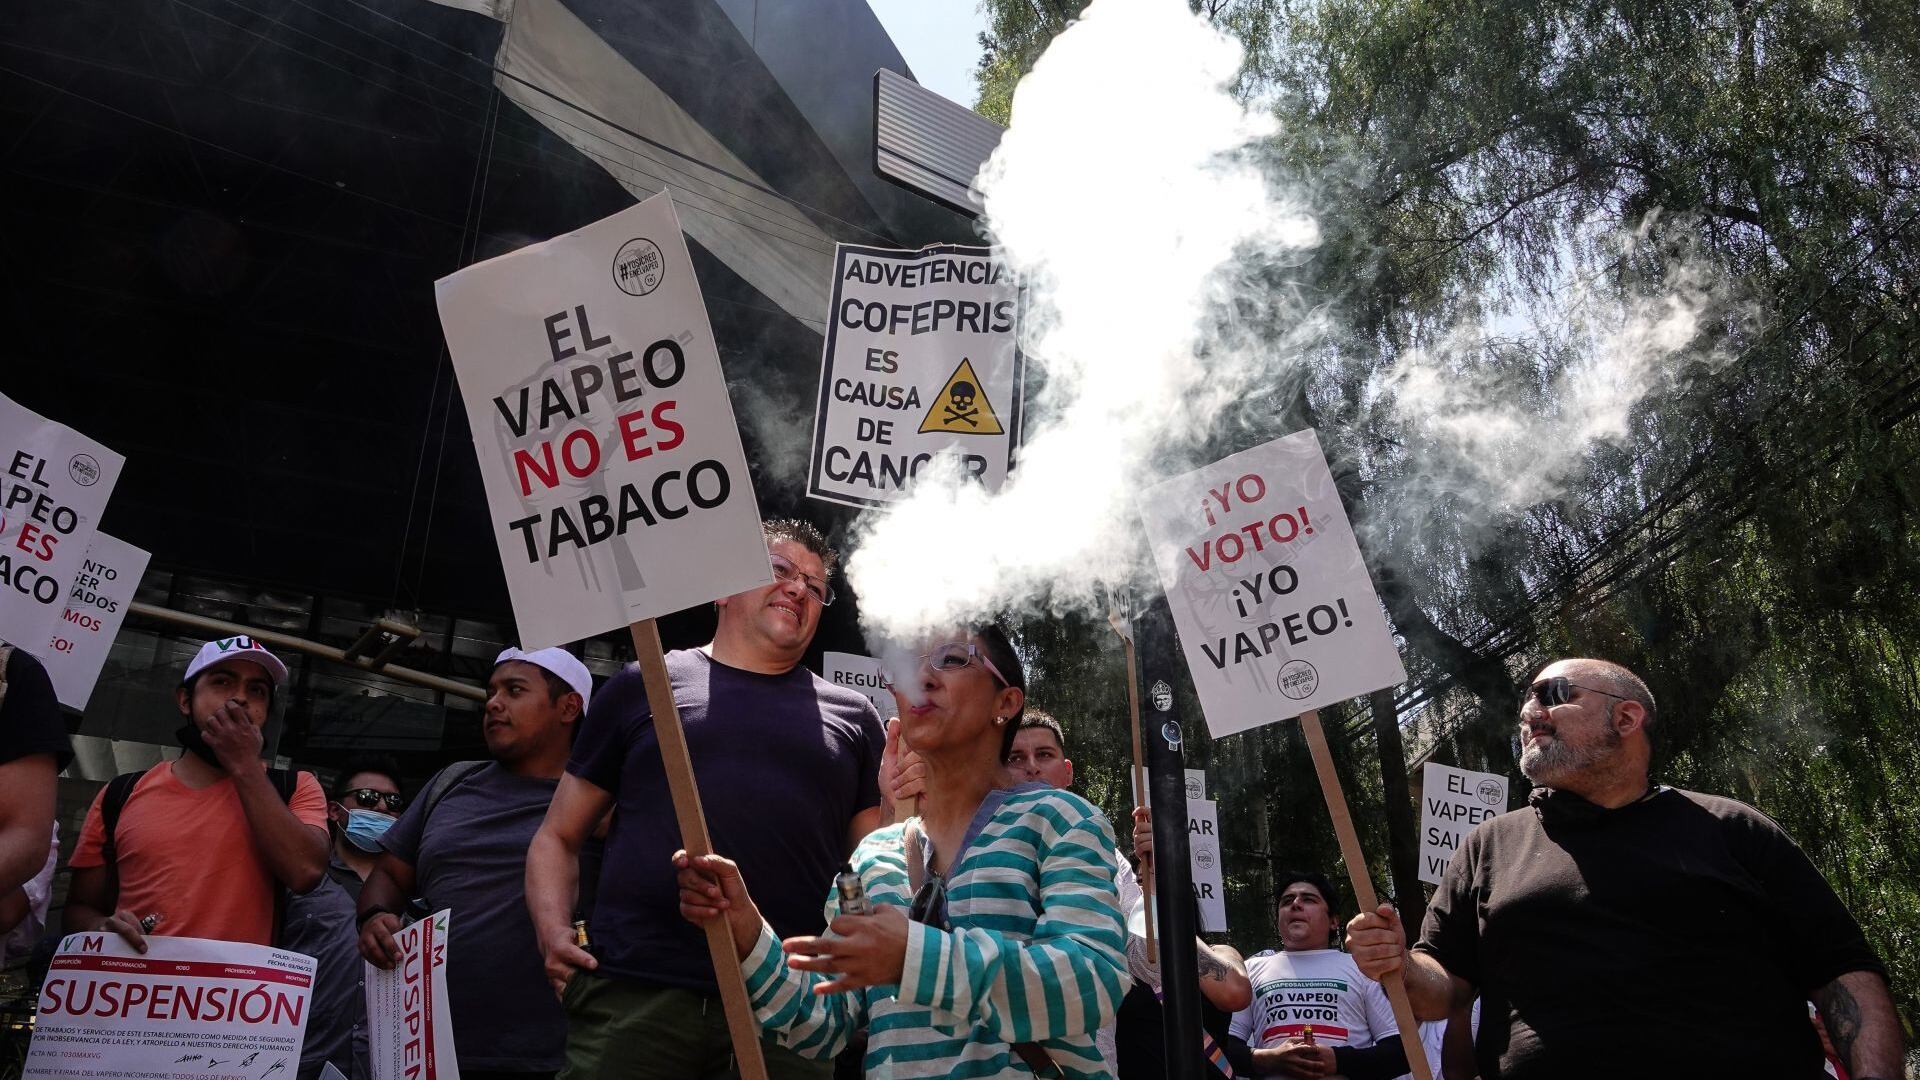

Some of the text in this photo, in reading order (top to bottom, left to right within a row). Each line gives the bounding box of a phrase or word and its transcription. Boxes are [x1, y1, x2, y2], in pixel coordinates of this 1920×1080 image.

[844, 259, 1014, 288] ADVETENCIA
[840, 298, 1016, 336] COFEPRIS
[543, 304, 612, 363] EL
[865, 347, 899, 374] ES
[493, 338, 686, 438] VAPEO
[834, 378, 922, 411] CAUSA
[856, 417, 894, 446] DE
[513, 400, 685, 497] NO ES
[8, 450, 50, 489] EL
[824, 445, 989, 491] CANCR
[0, 478, 78, 535] PEO
[509, 459, 731, 564] TABACO
[1202, 473, 1266, 526] ¡YO
[16, 522, 59, 562] ES
[1184, 506, 1314, 572] VOTO!
[82, 558, 118, 581] NTO
[71, 586, 118, 613] ADOS
[1232, 564, 1299, 618] ¡YO
[63, 608, 102, 632] MOS
[1200, 597, 1353, 670] VAPEO!
[834, 670, 887, 690] REGUL
[1447, 774, 1473, 796] EL
[1188, 818, 1214, 836] AR
[1427, 855, 1450, 878] VI
[1191, 882, 1215, 899] AR
[267, 959, 288, 968] FECHA:
[40, 979, 304, 1027] SUSPENSIÓN
[1264, 992, 1339, 1007] ¡YO VAPEO!
[1266, 1008, 1338, 1025] ¡YO VOTO!
[46, 1035, 100, 1044] INOBSERVANCIA
[141, 1039, 180, 1047] ATROPELLO
[222, 1042, 258, 1050] DERECHOS
[259, 1044, 295, 1052] HUMANOS
[143, 1031, 200, 1039] ESTABLECIMIENTO
[259, 1036, 296, 1044] SEGURIDAD
[96, 1070, 123, 1078] VAPERO
